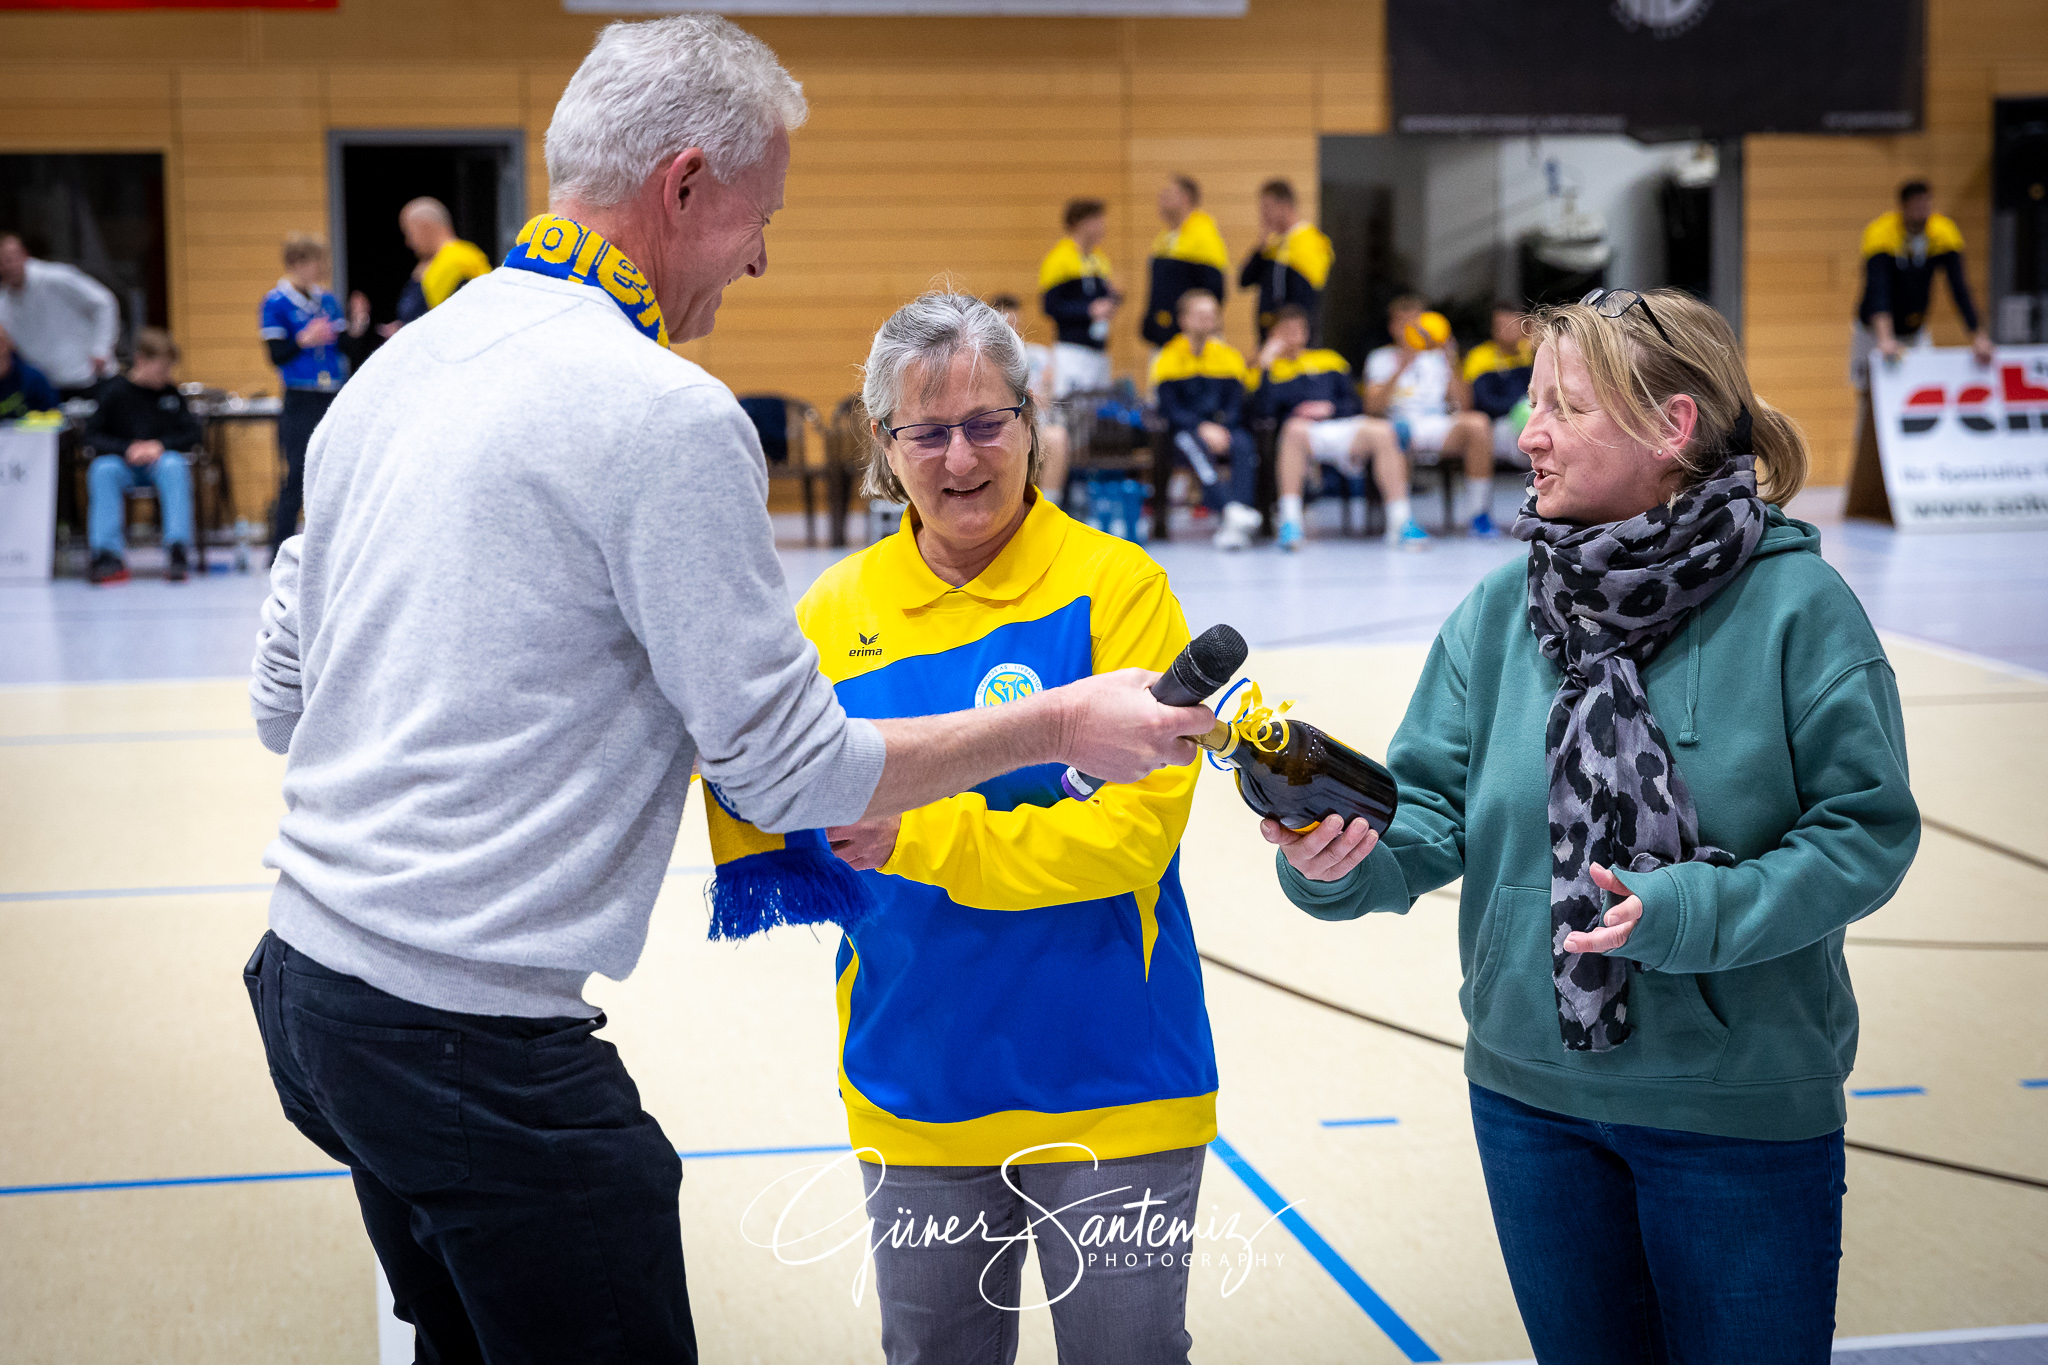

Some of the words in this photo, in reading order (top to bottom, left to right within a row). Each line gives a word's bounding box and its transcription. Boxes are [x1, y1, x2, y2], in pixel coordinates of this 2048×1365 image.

[849, 646, 882, 657] erima
[977, 669, 998, 695] SCHWAIG
[1014, 665, 1041, 692] VOLLEYBALL
